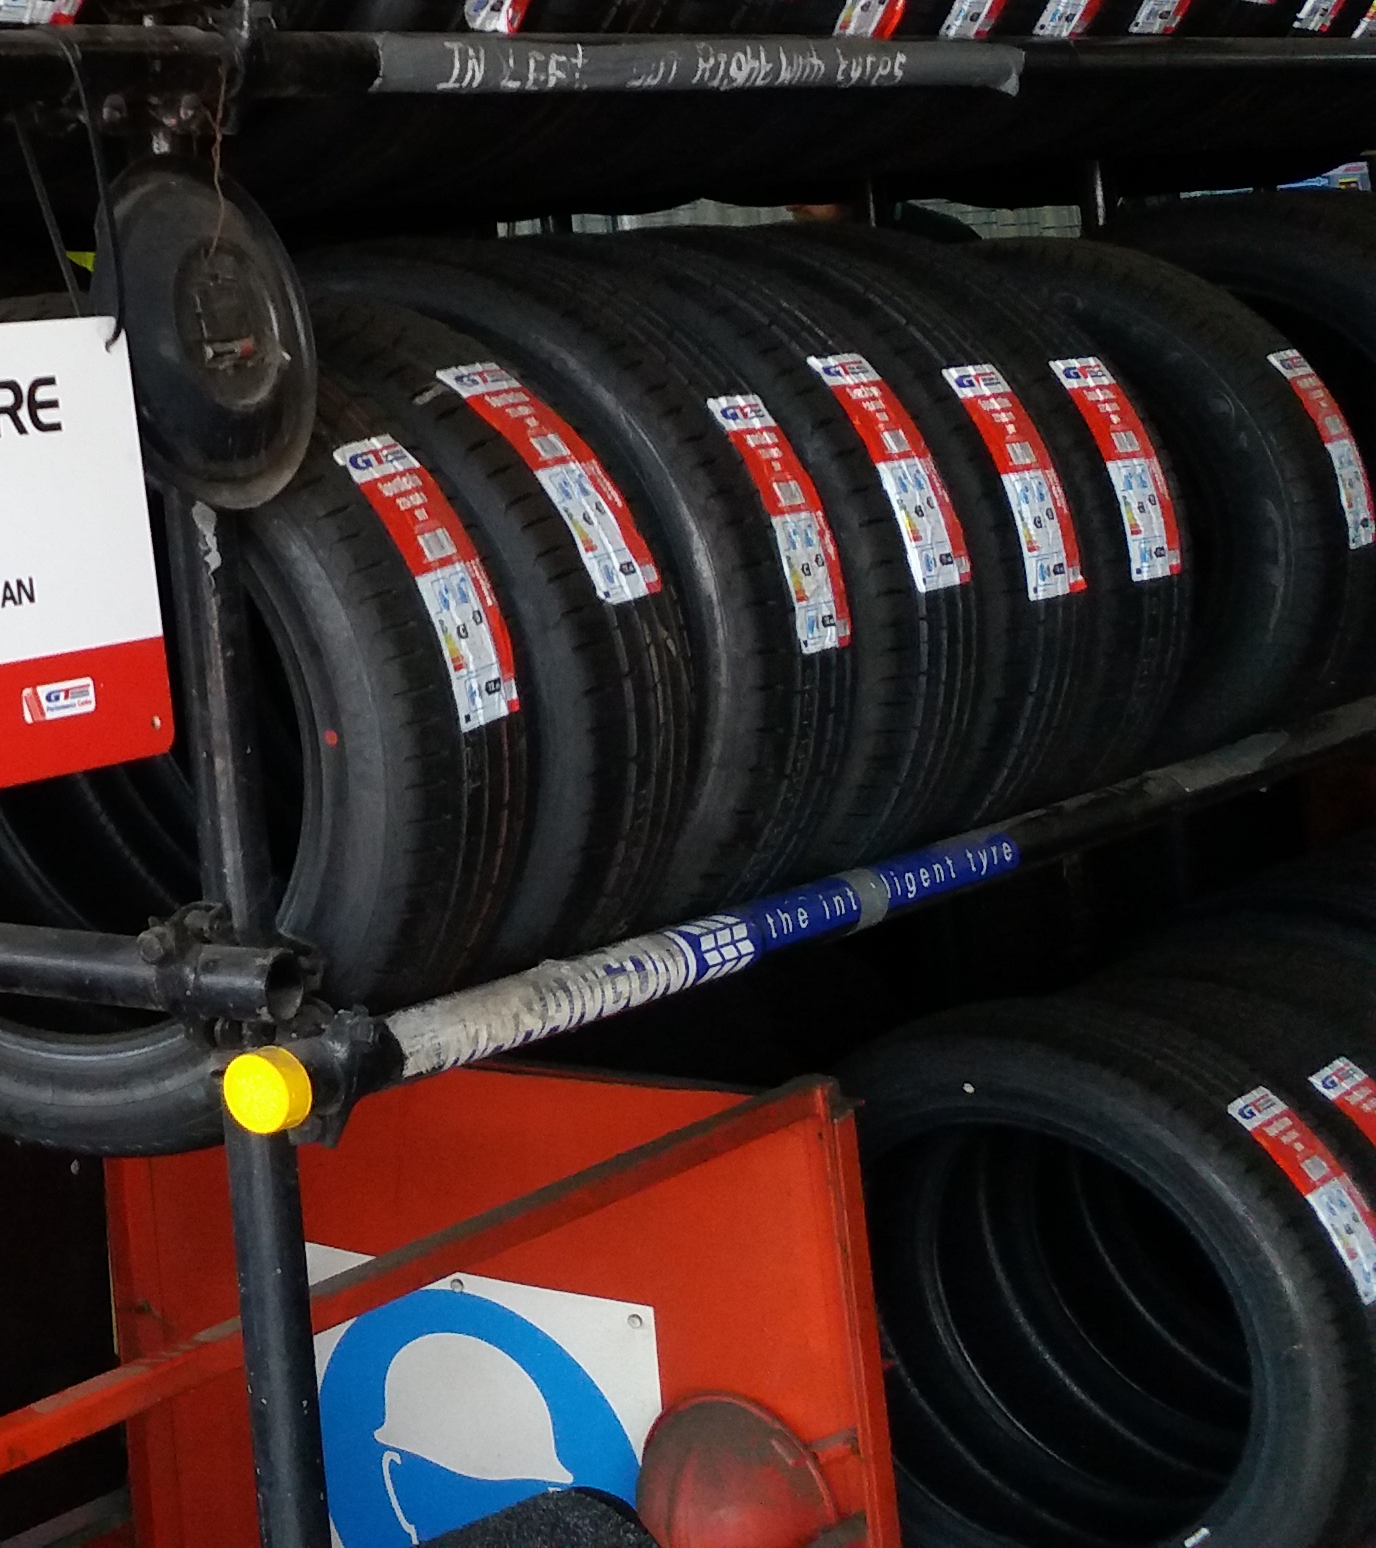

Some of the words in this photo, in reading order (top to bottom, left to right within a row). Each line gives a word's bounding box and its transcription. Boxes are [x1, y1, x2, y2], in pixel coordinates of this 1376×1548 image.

[436, 41, 485, 91] IN
[765, 905, 811, 940] the
[966, 839, 1014, 876] tyre
